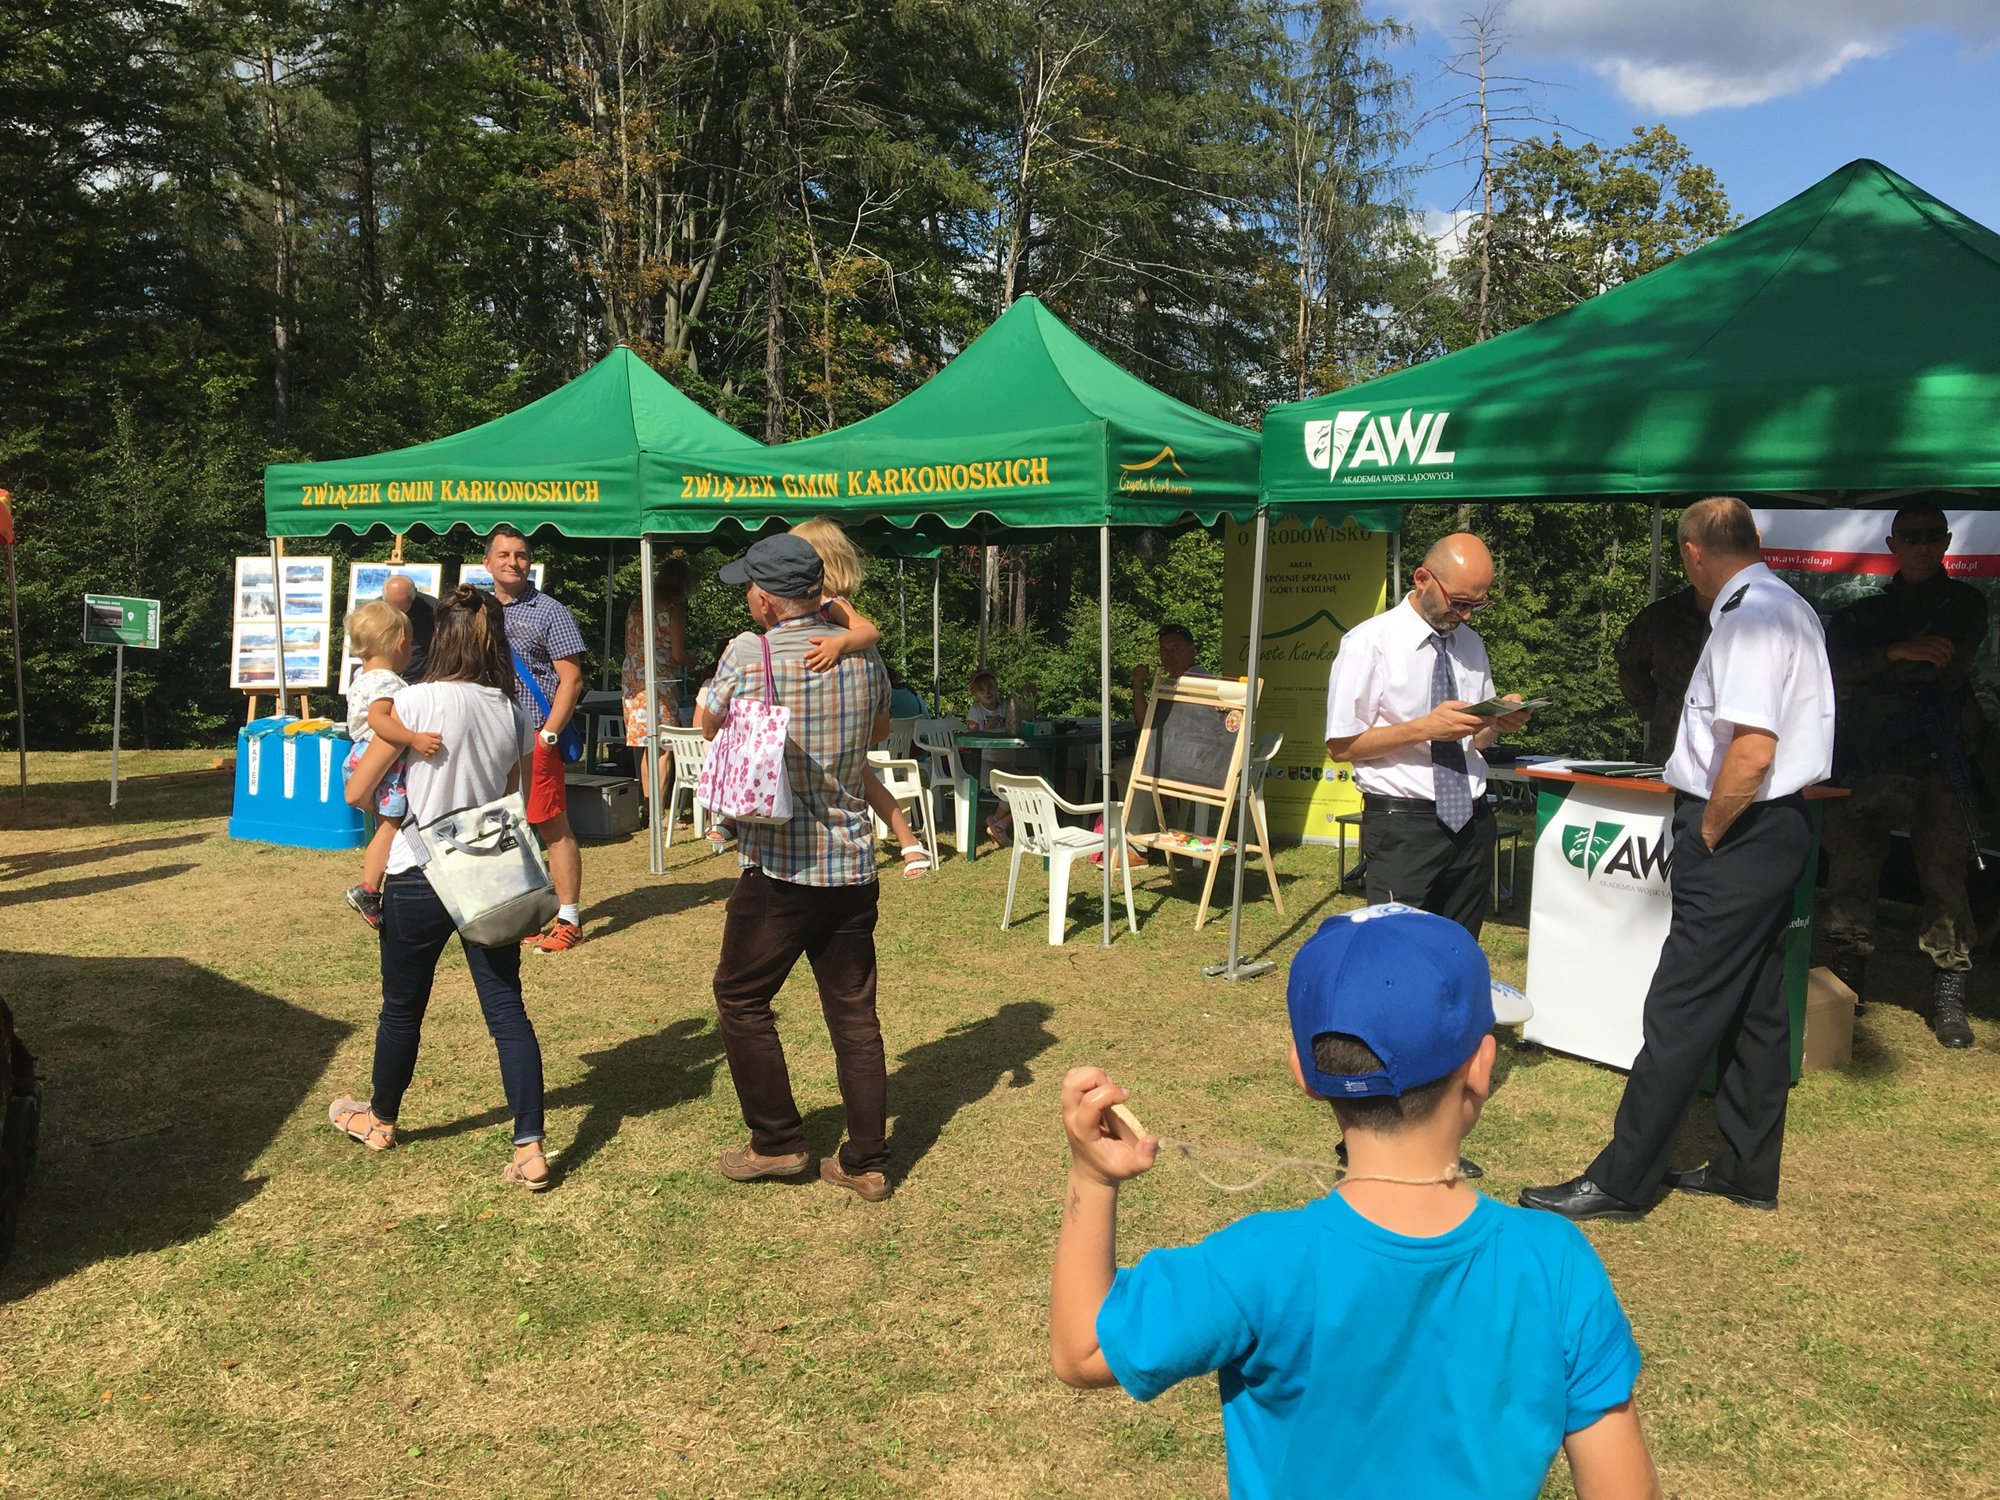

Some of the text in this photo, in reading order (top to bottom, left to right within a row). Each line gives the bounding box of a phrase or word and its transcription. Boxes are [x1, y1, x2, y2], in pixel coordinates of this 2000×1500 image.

[1347, 407, 1456, 468] AWL
[680, 457, 1051, 503] ZWIĄZEK GMIN KARKONOSKICH
[1342, 474, 1381, 484] AKADEMIA
[1382, 473, 1407, 484] WOJSK
[301, 479, 600, 510] ZWIĄZEK GMIN KARKONOSKICH
[1238, 526, 1372, 546] O RODOWISKO
[1763, 555, 1833, 567] ww.awl.edu.pl
[1944, 560, 1978, 572] l.edu.pl
[1264, 573, 1352, 583] SPÓLNIE SPRZĄTAMY
[1269, 584, 1293, 594] GÓRY
[1301, 584, 1337, 594] KOTLINĘ
[1287, 640, 1338, 661] Karko
[1599, 880, 1636, 893] AKADEMIA
[1636, 886, 1661, 896] WOJSK
